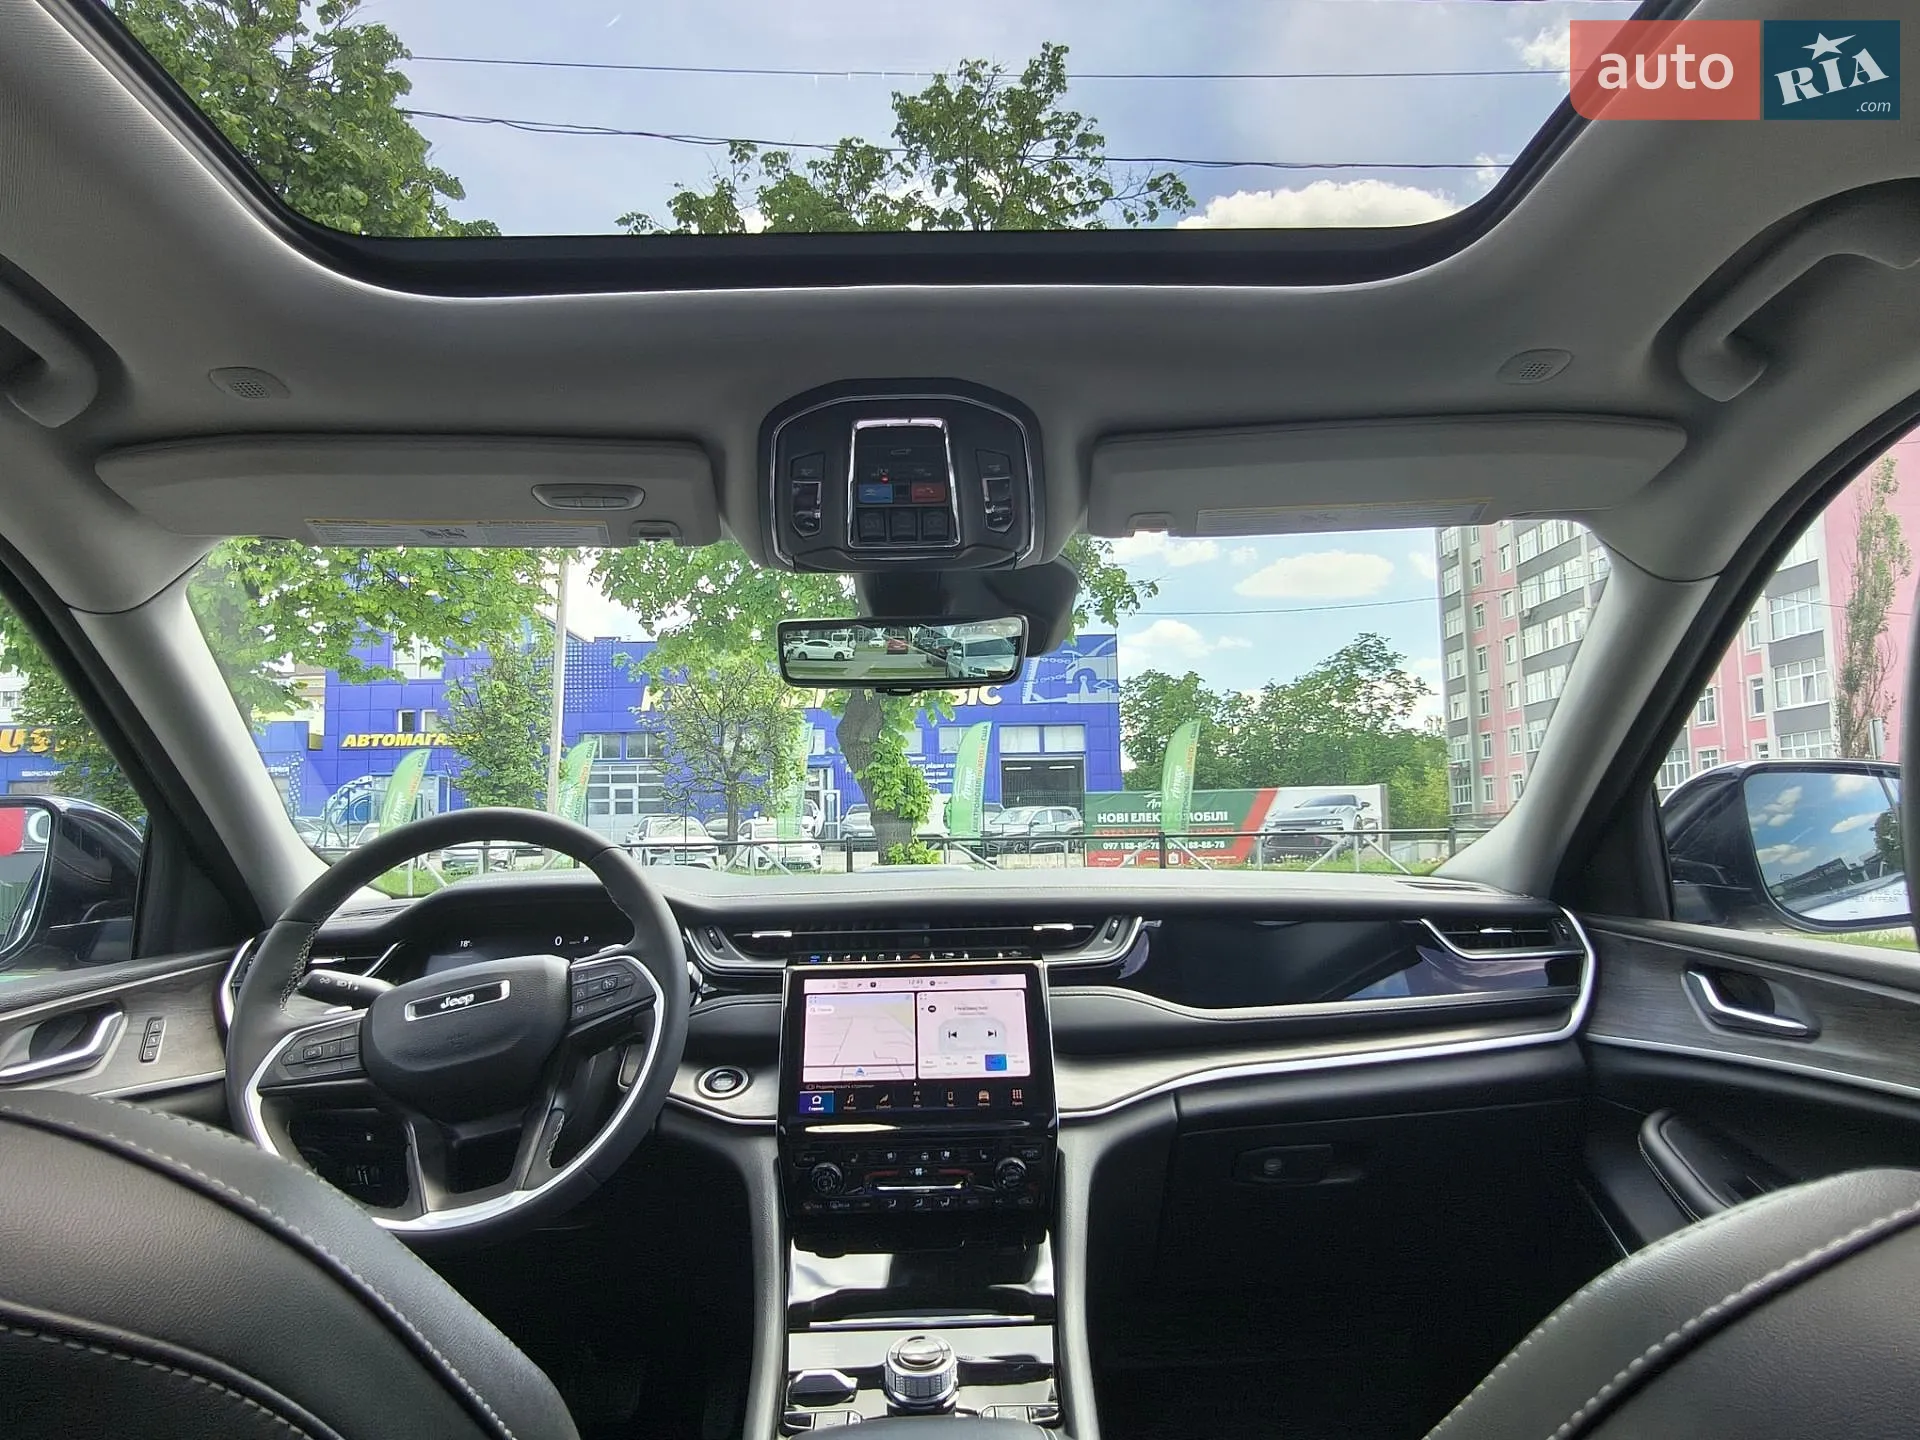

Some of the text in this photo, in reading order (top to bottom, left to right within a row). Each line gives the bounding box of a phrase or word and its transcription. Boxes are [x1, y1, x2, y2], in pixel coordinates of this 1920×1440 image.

[342, 733, 482, 747] АВТОМАГА
[1097, 811, 1228, 823] НОВІ ЕЛЕКМОБІЛІ
[440, 993, 475, 1009] Jeep
